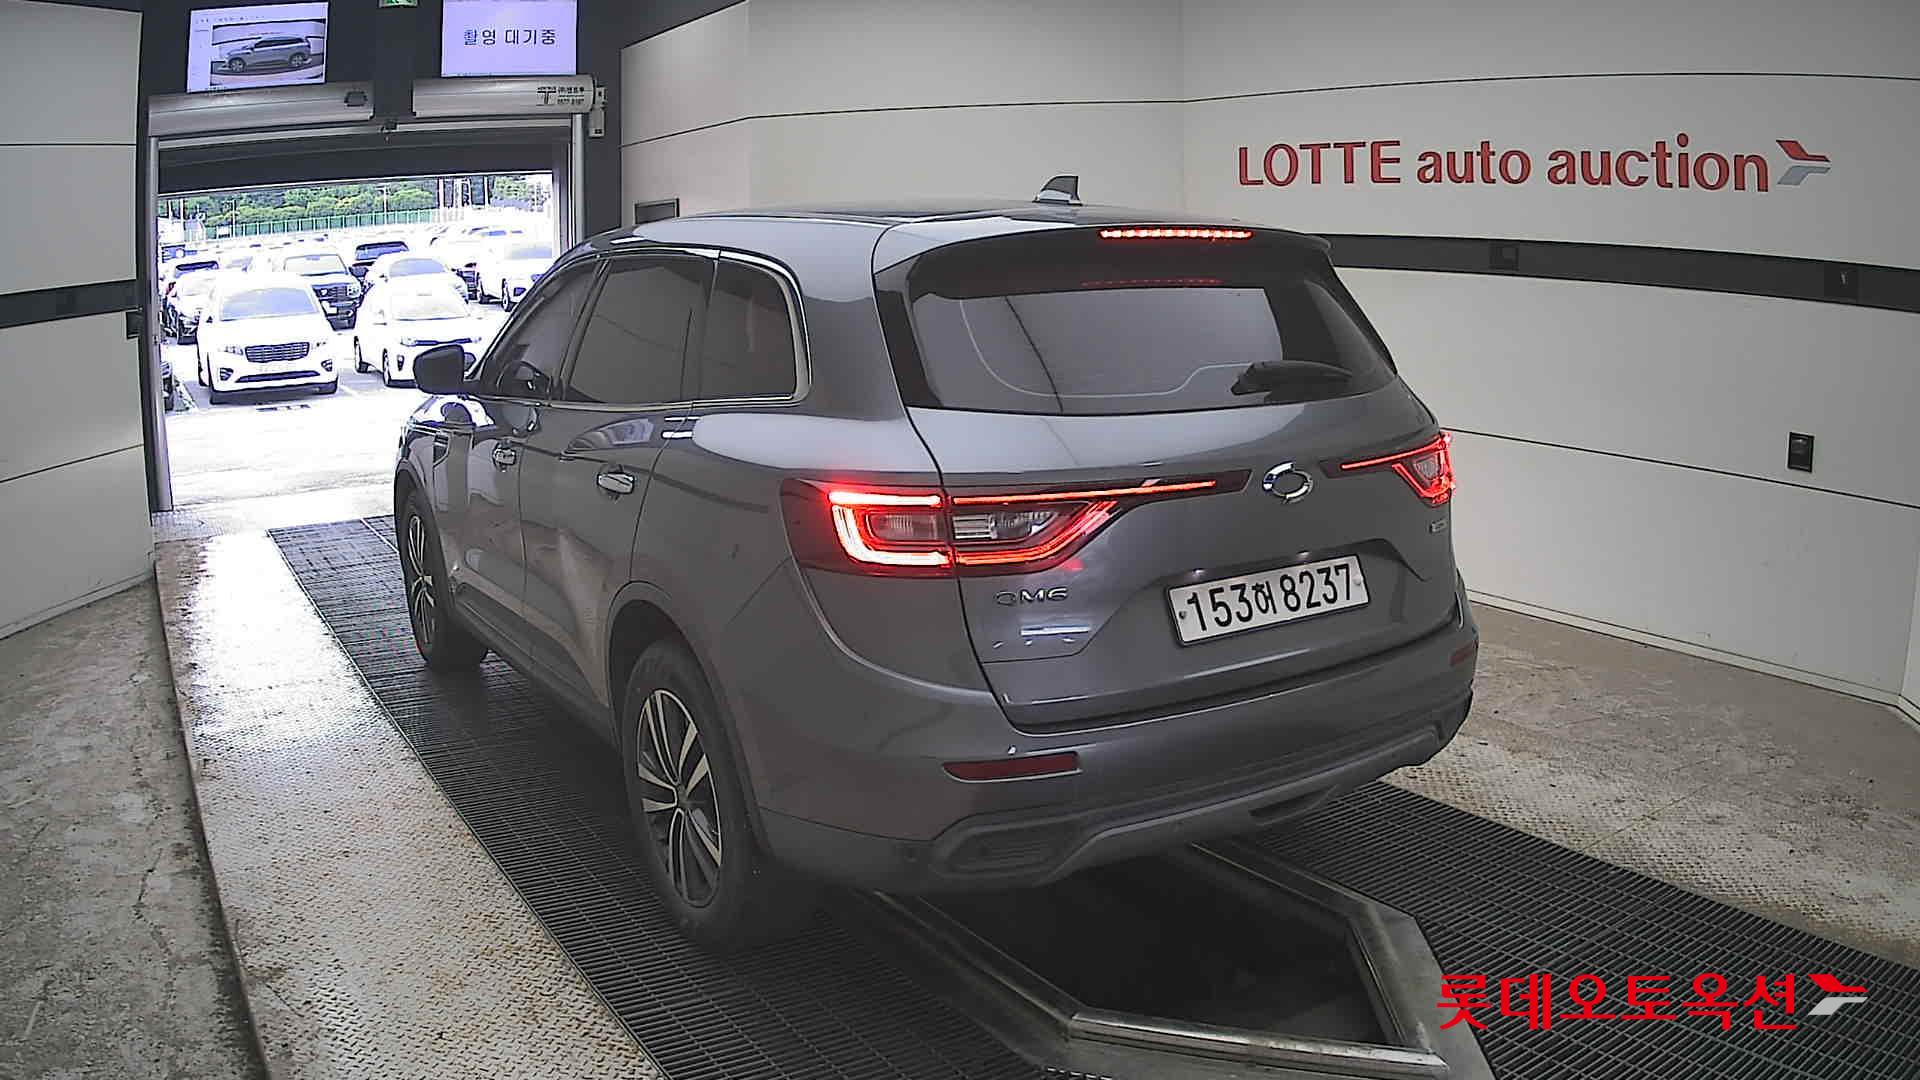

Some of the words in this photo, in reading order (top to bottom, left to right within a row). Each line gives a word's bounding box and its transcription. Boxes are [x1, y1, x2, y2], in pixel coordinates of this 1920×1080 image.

[463, 28, 497, 46] 촬영
[504, 28, 557, 46] 대기중
[1238, 140, 1401, 187] LOTTE
[1415, 140, 1532, 185] auto
[1547, 132, 1770, 193] auction
